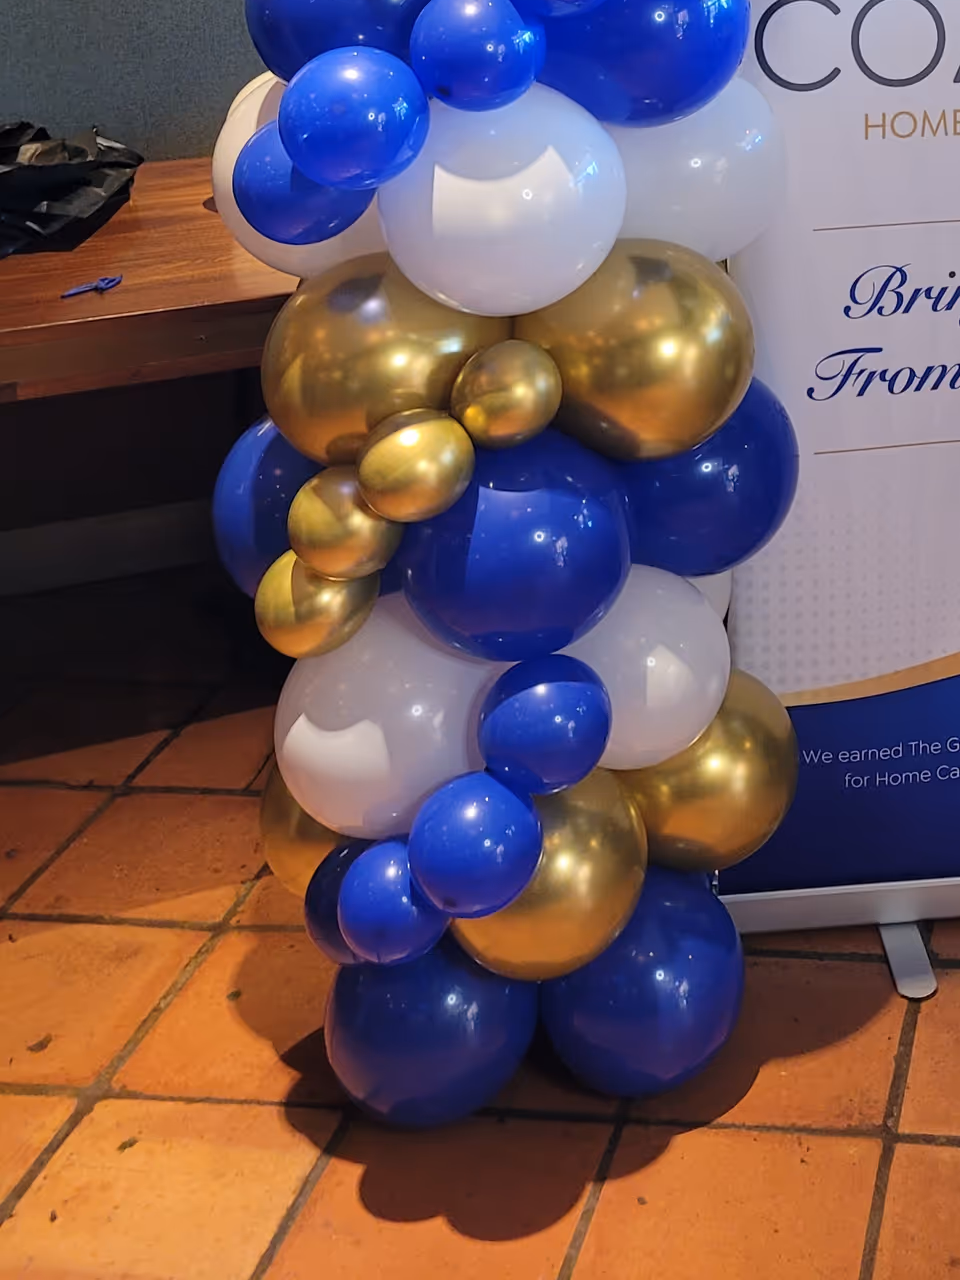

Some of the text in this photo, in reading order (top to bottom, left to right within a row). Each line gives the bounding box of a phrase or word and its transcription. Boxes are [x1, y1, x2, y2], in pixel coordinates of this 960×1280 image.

[802, 748, 833, 764] We
[838, 742, 903, 763] earned
[908, 739, 942, 756] The
[845, 772, 870, 788] for
[876, 770, 932, 787] Home
